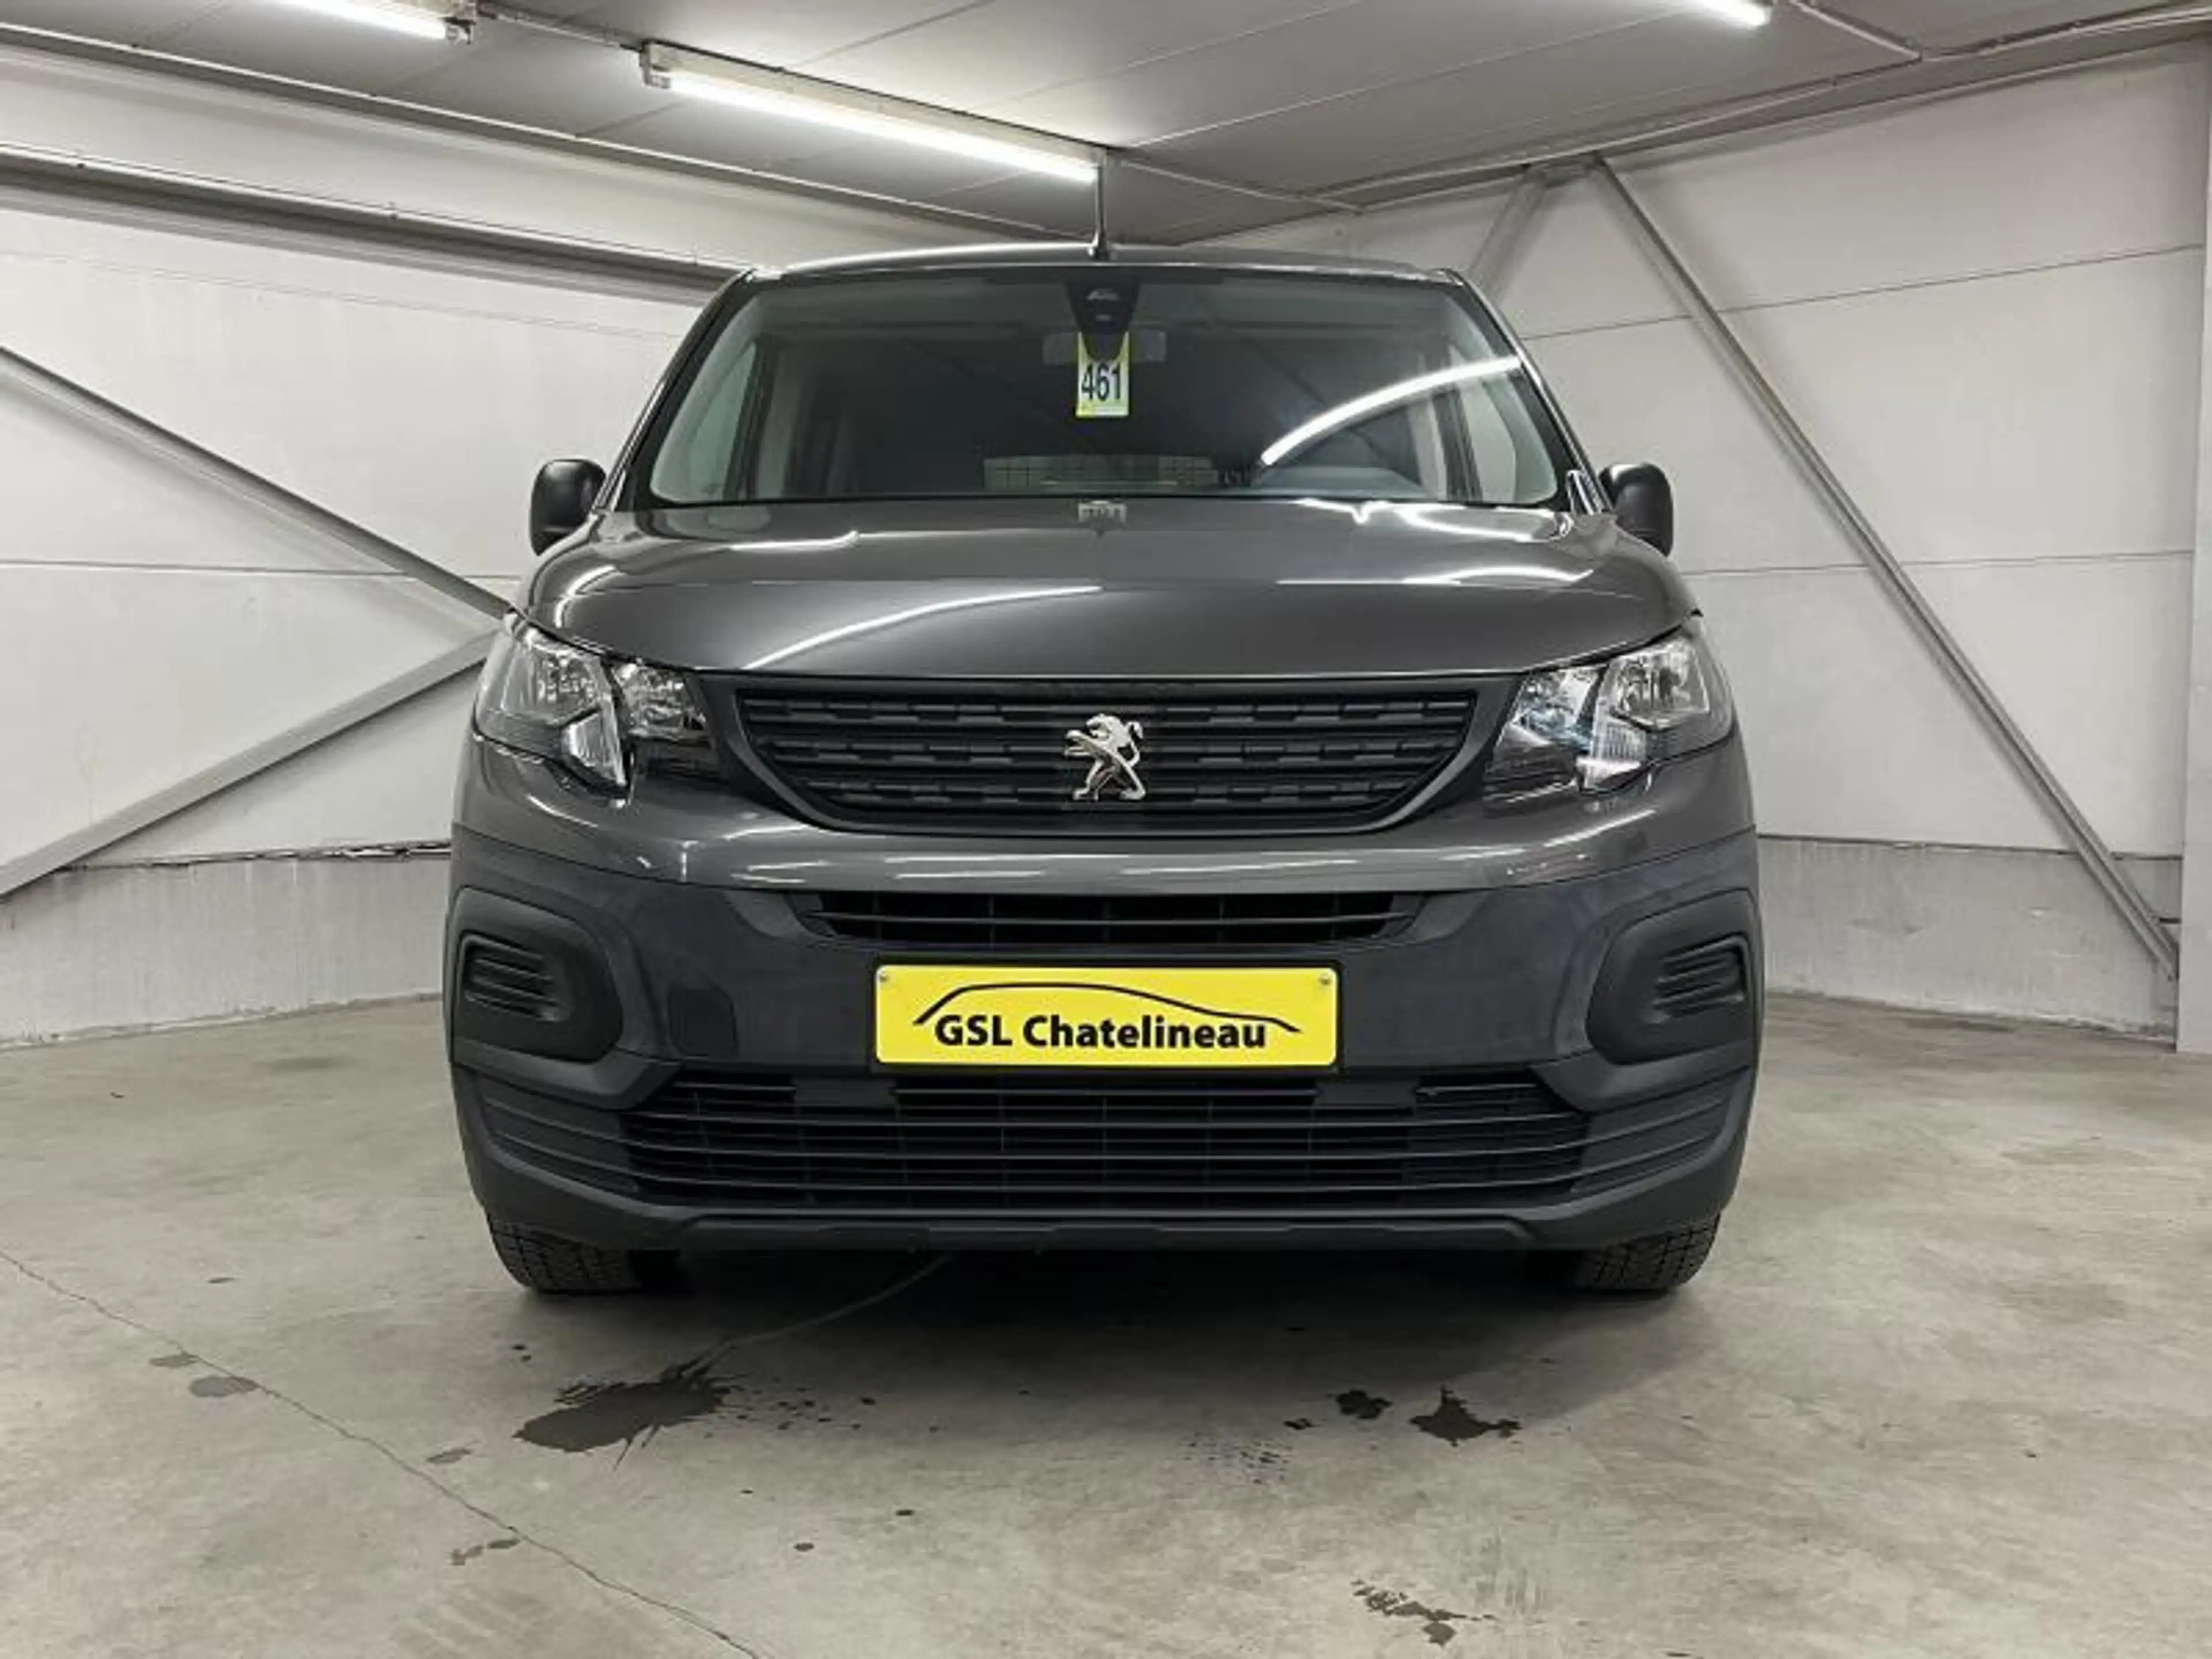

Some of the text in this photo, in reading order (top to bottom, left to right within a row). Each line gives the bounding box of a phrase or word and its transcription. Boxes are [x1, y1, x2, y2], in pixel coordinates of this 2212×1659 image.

[1082, 363, 1120, 402] 461
[935, 1014, 1266, 1048] GSL Chatelineau
